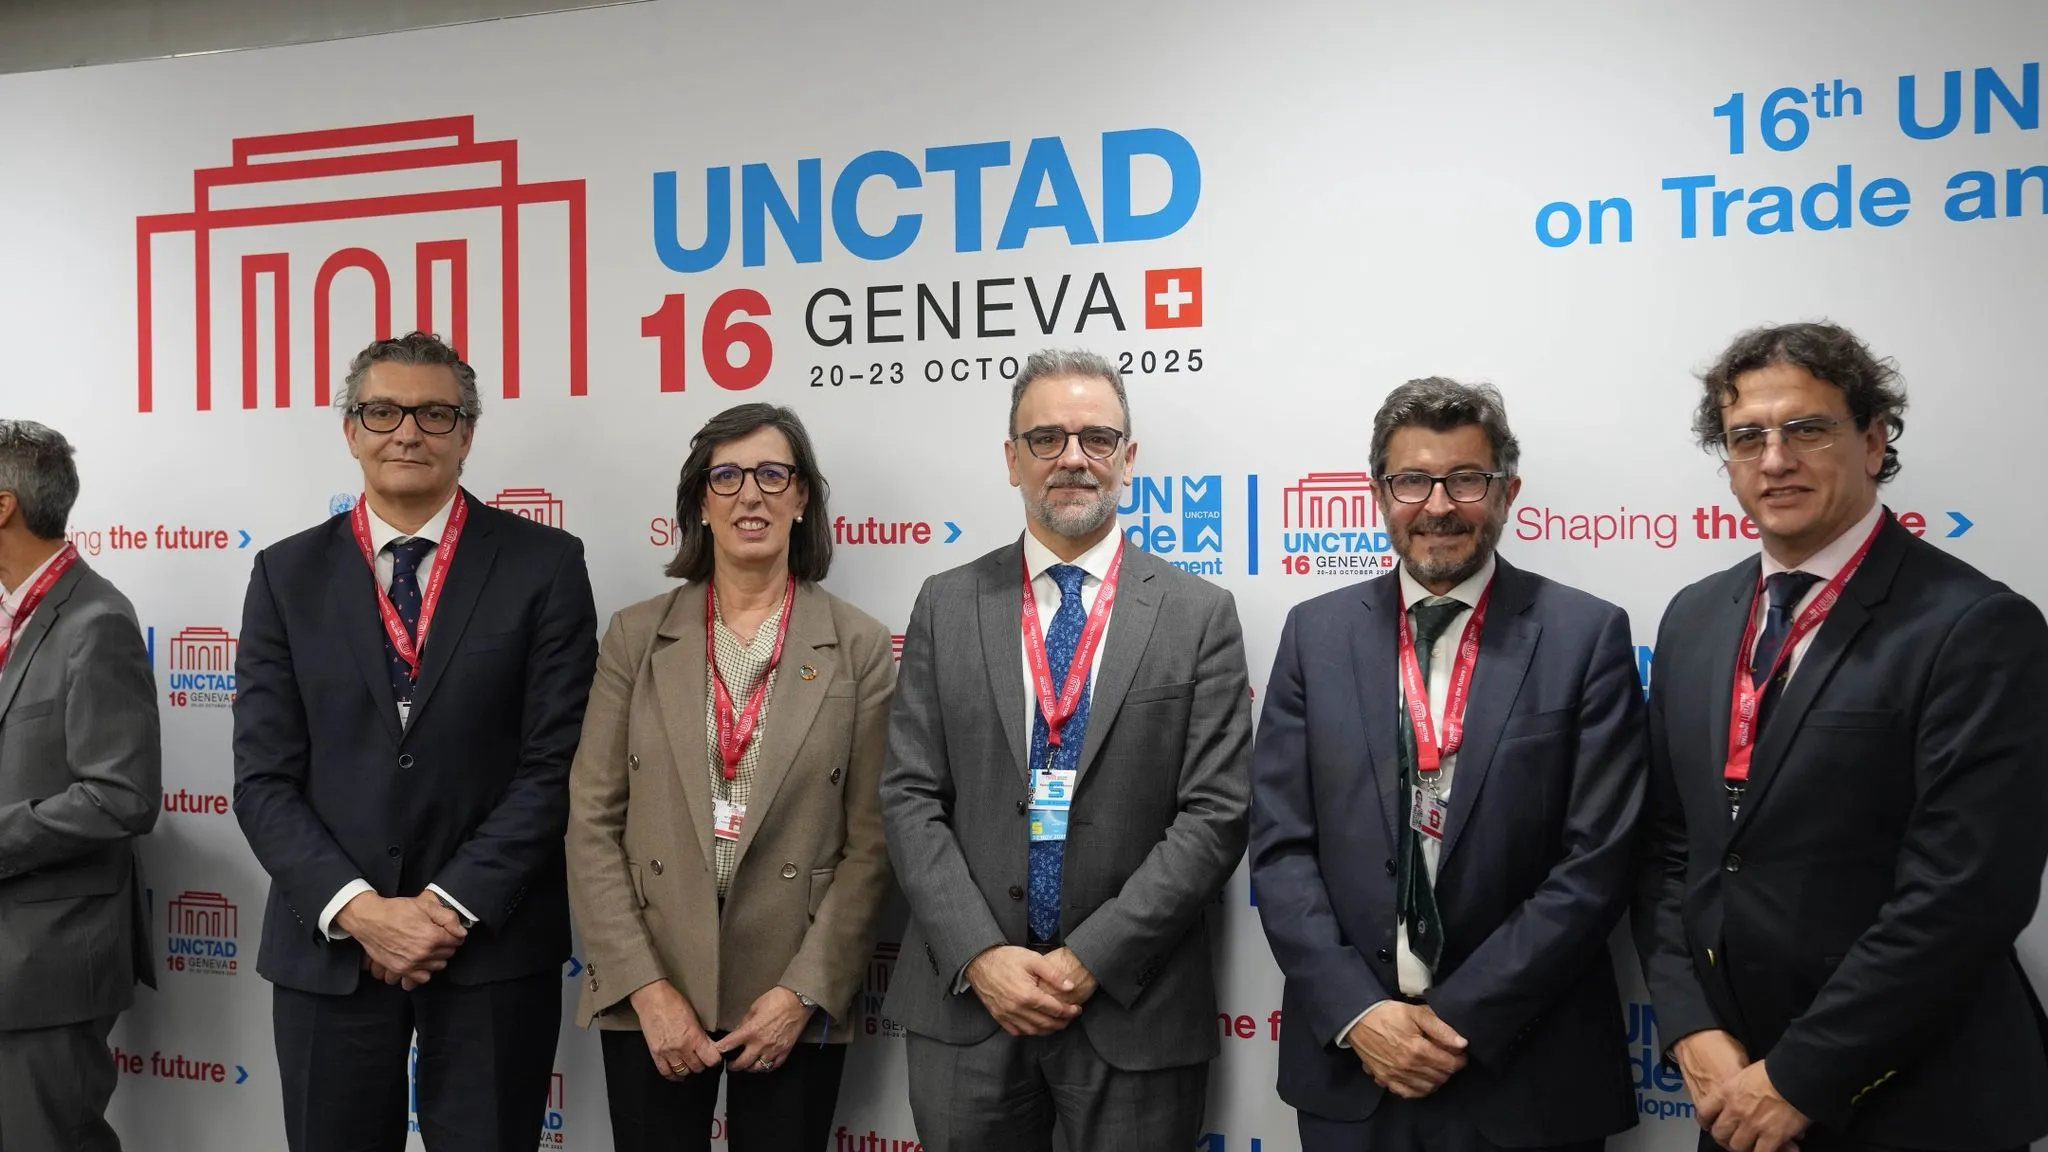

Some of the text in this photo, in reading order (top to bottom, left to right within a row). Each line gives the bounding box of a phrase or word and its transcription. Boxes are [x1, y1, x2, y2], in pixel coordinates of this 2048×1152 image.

[1713, 62, 2039, 155] 16th UN
[653, 127, 1201, 273] UNCTAD
[1534, 164, 2048, 248] on Trade an
[641, 272, 1126, 393] 16 GENEVA
[925, 356, 1019, 383] OCTO
[1118, 349, 1203, 375] 2025
[1185, 511, 1220, 519] UNCTAD
[1515, 506, 1759, 548] Shaping the
[109, 525, 147, 549] the
[155, 525, 228, 549] future
[833, 516, 931, 544] future
[1283, 532, 1391, 553] UNCTAD
[1281, 555, 1378, 574] 16 GENEVA
[170, 674, 237, 690] UNCTAD
[1457, 669, 1466, 686] future
[169, 691, 229, 707] 16 GENEVA
[164, 788, 228, 815] uture
[168, 937, 237, 957] UNCTAD
[167, 955, 227, 971] 16 GENEVA
[865, 1017, 877, 1035] 6
[151, 1051, 225, 1083] future
